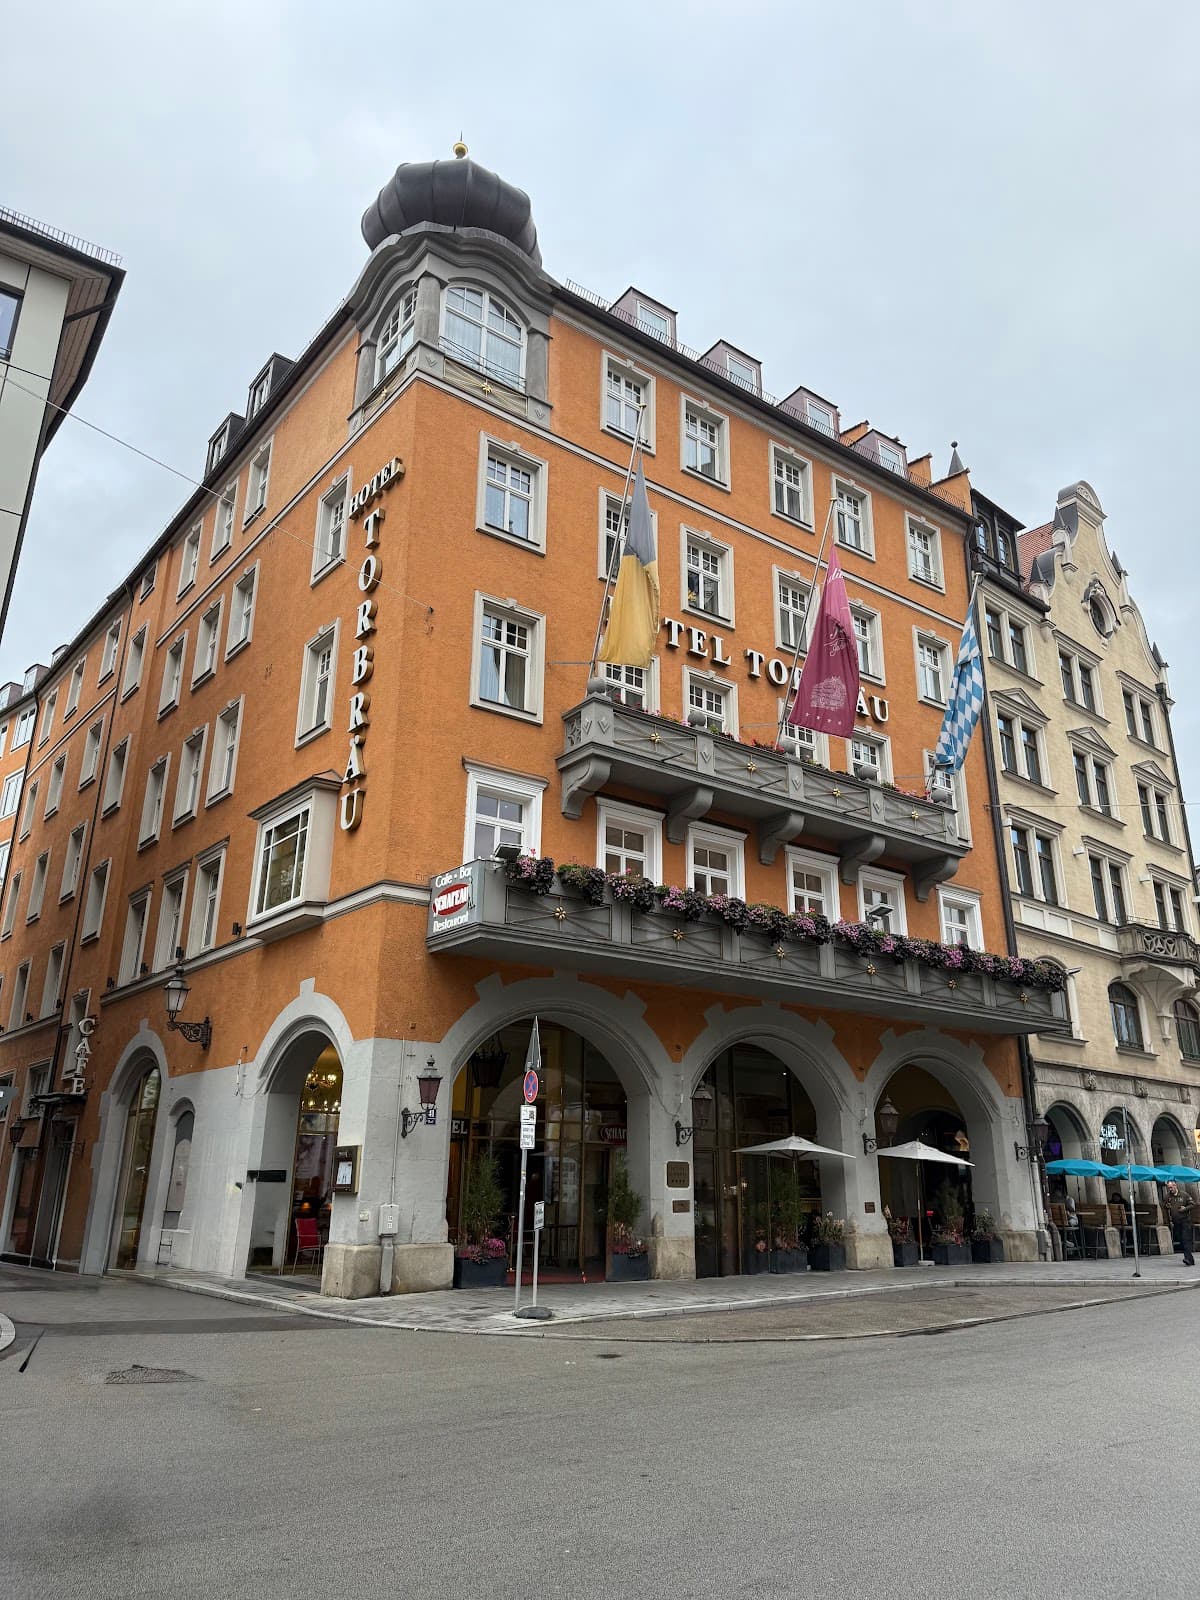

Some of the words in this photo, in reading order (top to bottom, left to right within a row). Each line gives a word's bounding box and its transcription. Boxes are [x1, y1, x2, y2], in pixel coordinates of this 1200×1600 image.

[349, 456, 403, 519] HOTEL
[340, 508, 384, 832] TORBRÄU
[664, 617, 732, 667] TEL
[459, 866, 472, 879] Bar
[433, 911, 469, 933] Restaurant
[70, 1018, 96, 1095] CAFE
